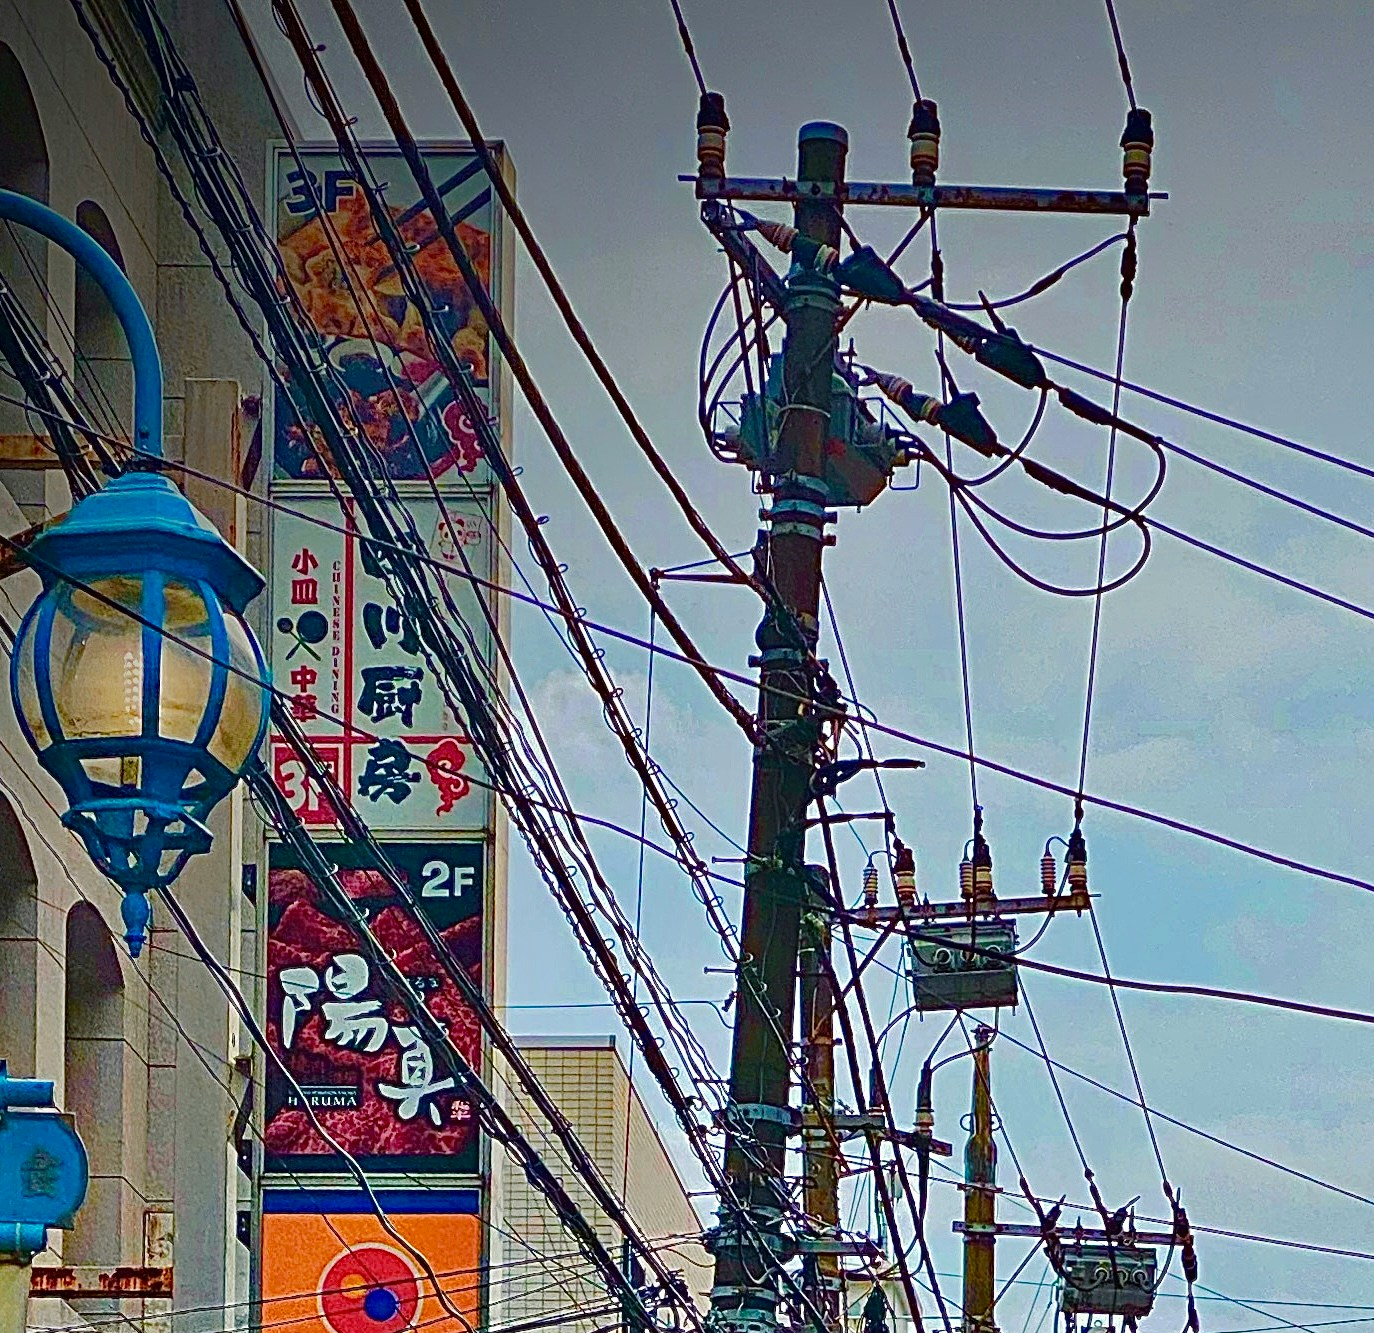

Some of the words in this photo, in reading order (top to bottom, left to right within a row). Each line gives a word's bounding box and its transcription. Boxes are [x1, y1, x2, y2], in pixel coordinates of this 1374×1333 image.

[284, 170, 358, 215] 3F
[291, 548, 318, 604] 小皿
[331, 560, 341, 641] CHINESE
[291, 665, 318, 722] 中華
[331, 646, 341, 714] DINING
[421, 860, 475, 898] 2F
